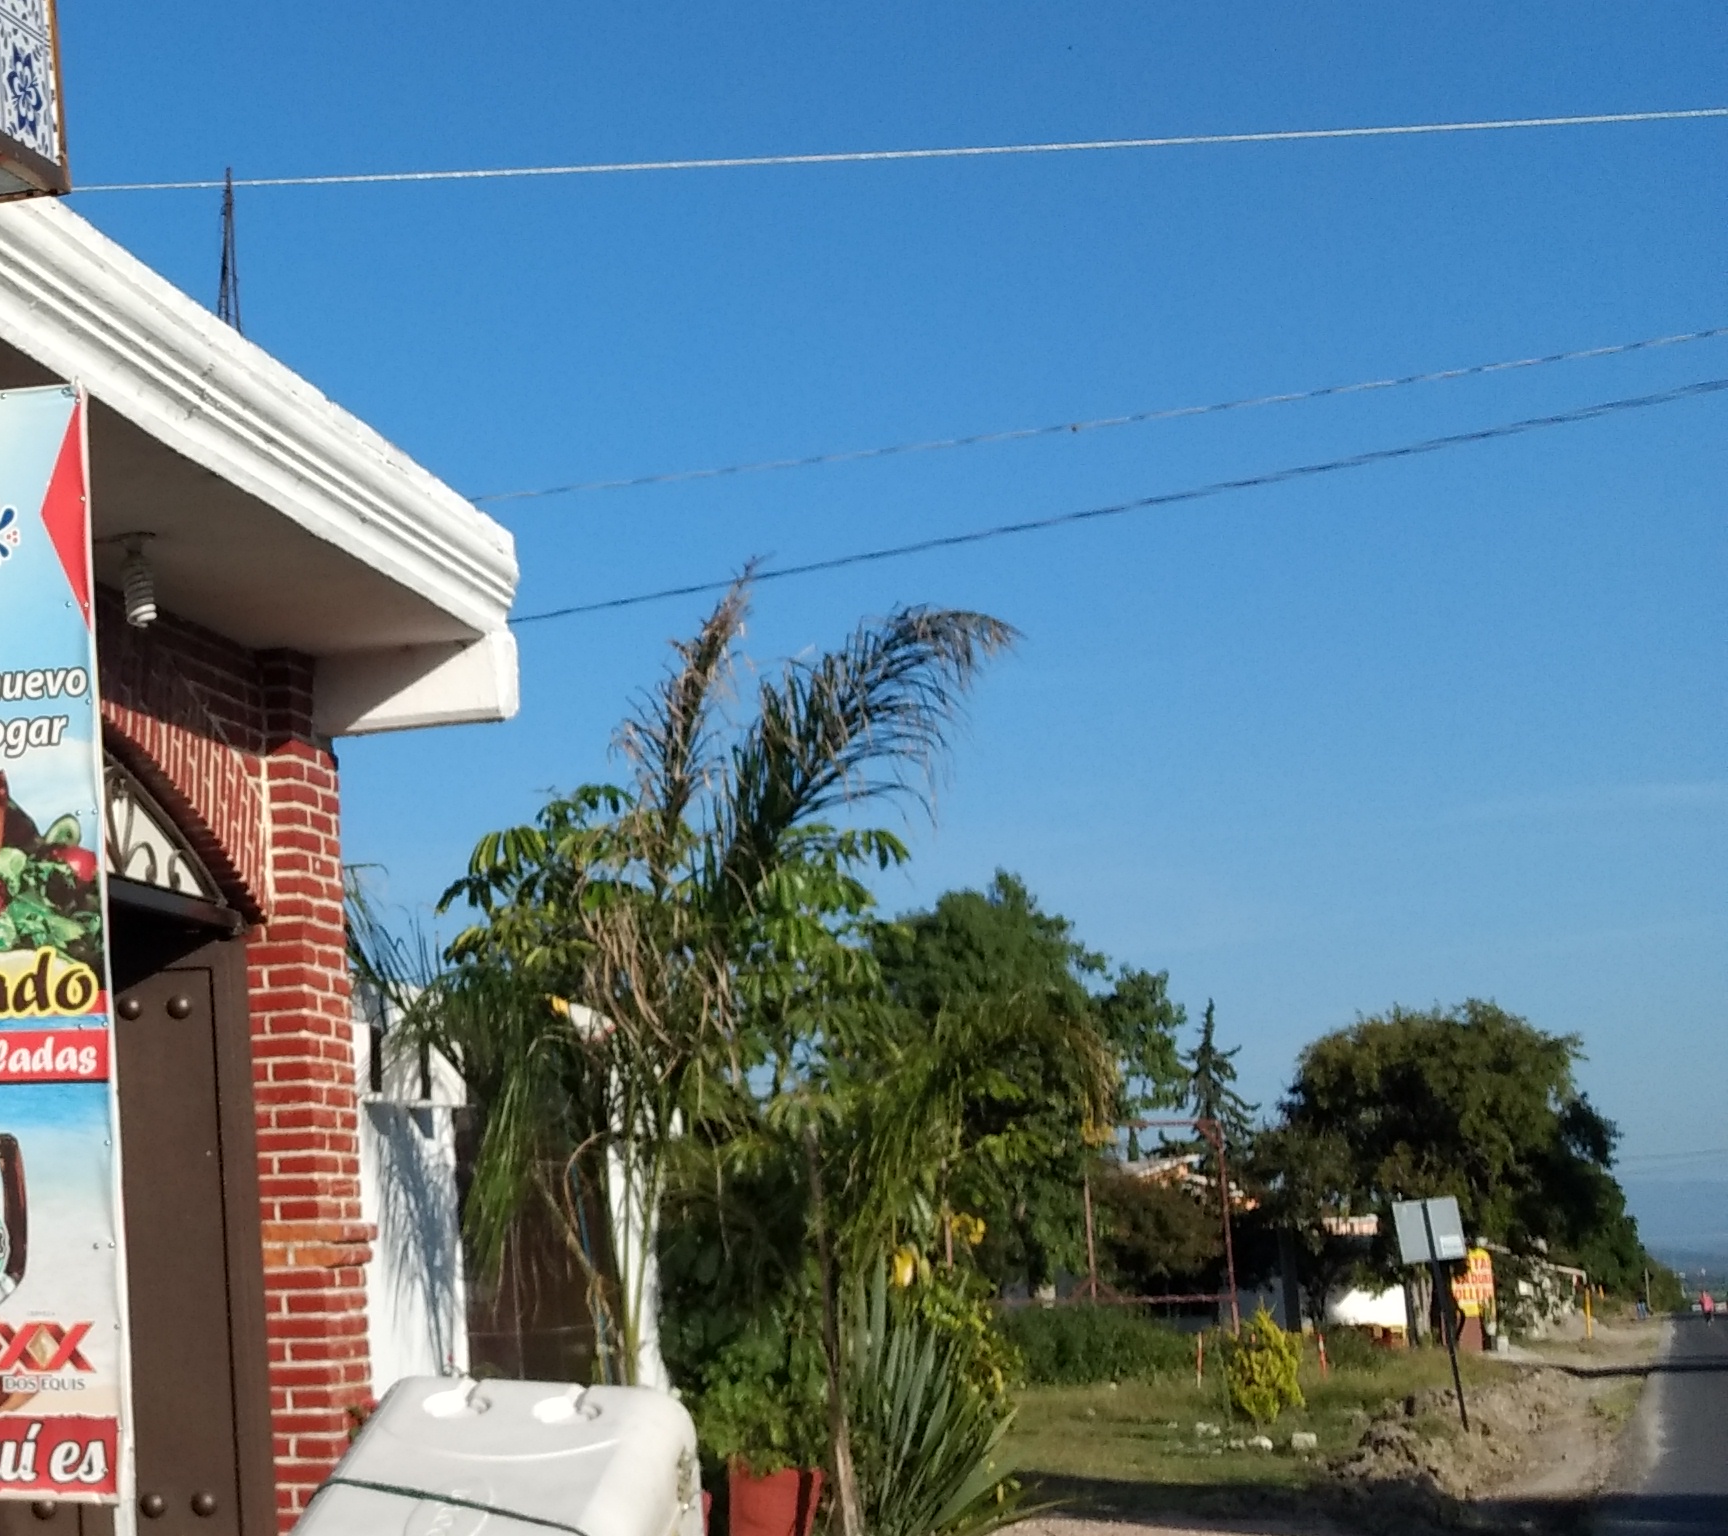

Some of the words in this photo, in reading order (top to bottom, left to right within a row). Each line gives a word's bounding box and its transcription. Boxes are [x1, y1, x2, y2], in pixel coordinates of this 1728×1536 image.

[4, 1378, 37, 1391] DOS
[41, 1378, 85, 1391] EQUIS
[49, 1440, 109, 1484] es
